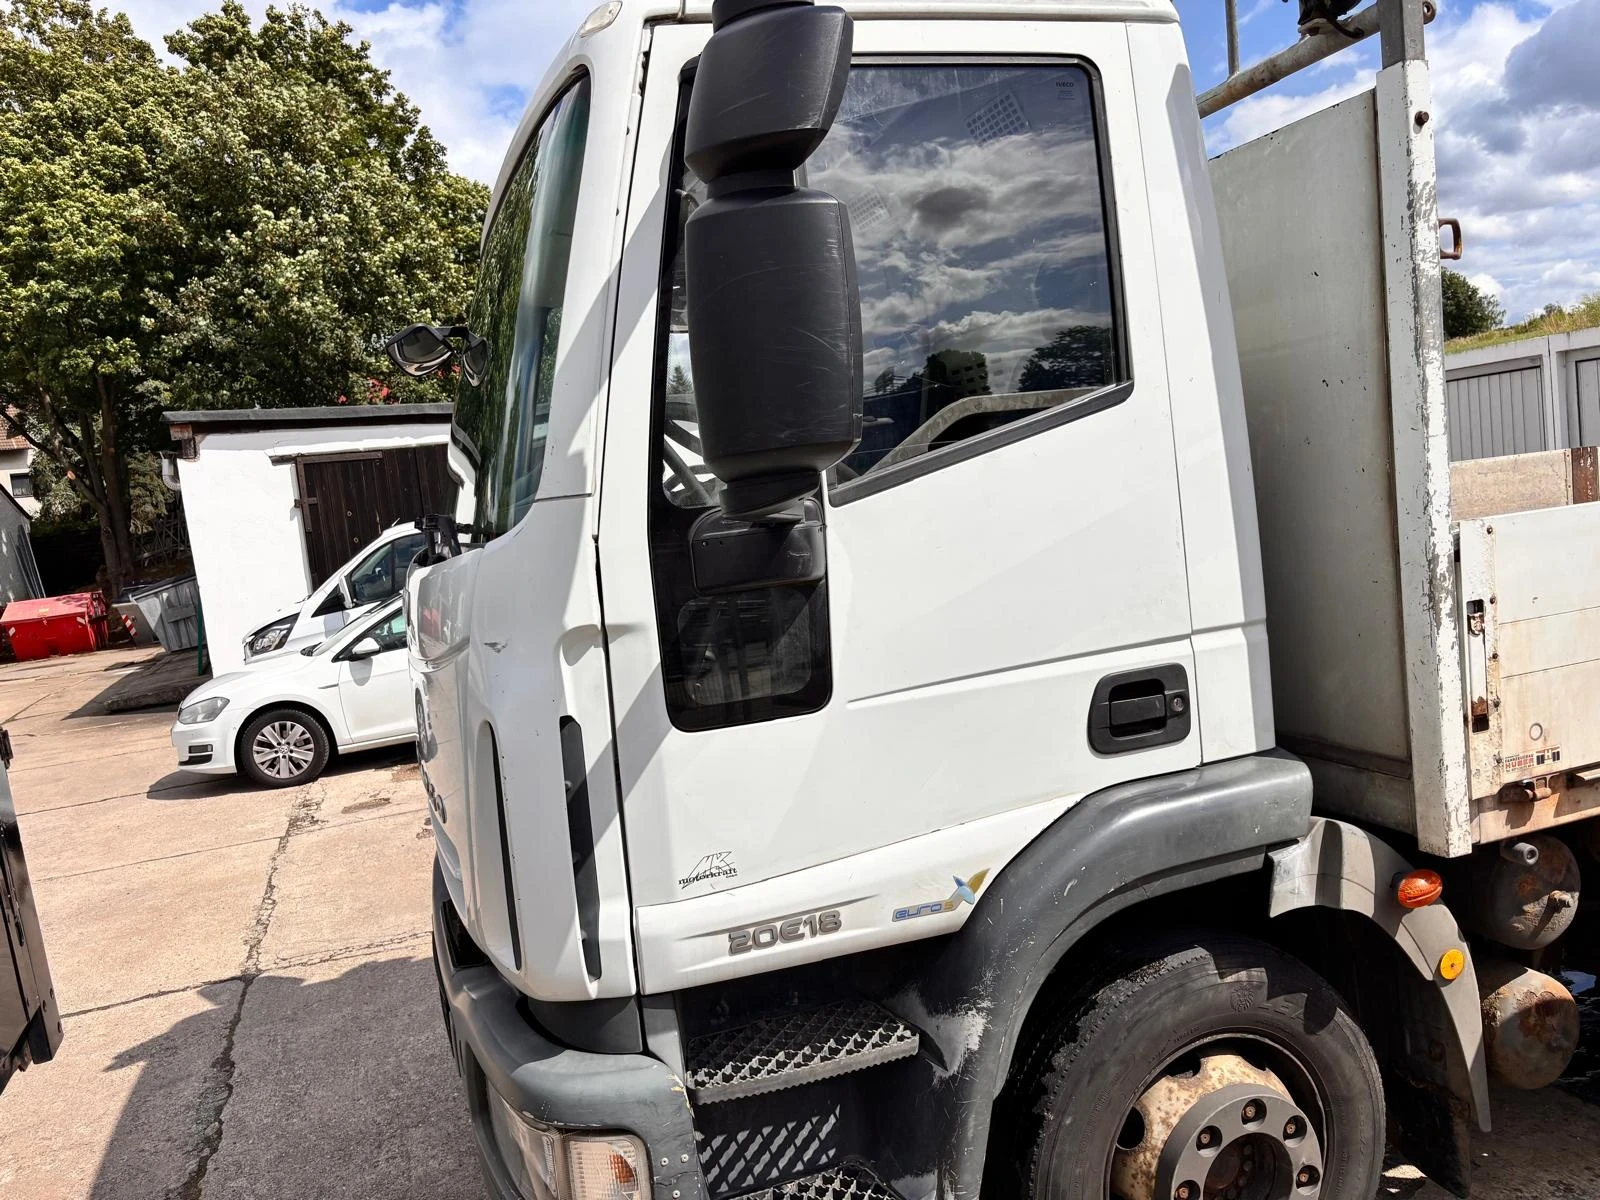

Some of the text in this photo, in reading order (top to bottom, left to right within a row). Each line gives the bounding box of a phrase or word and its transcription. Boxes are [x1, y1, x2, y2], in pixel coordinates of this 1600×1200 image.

[678, 867, 738, 885] motorkraft
[895, 903, 943, 919] euro
[728, 909, 842, 956] 20E18
